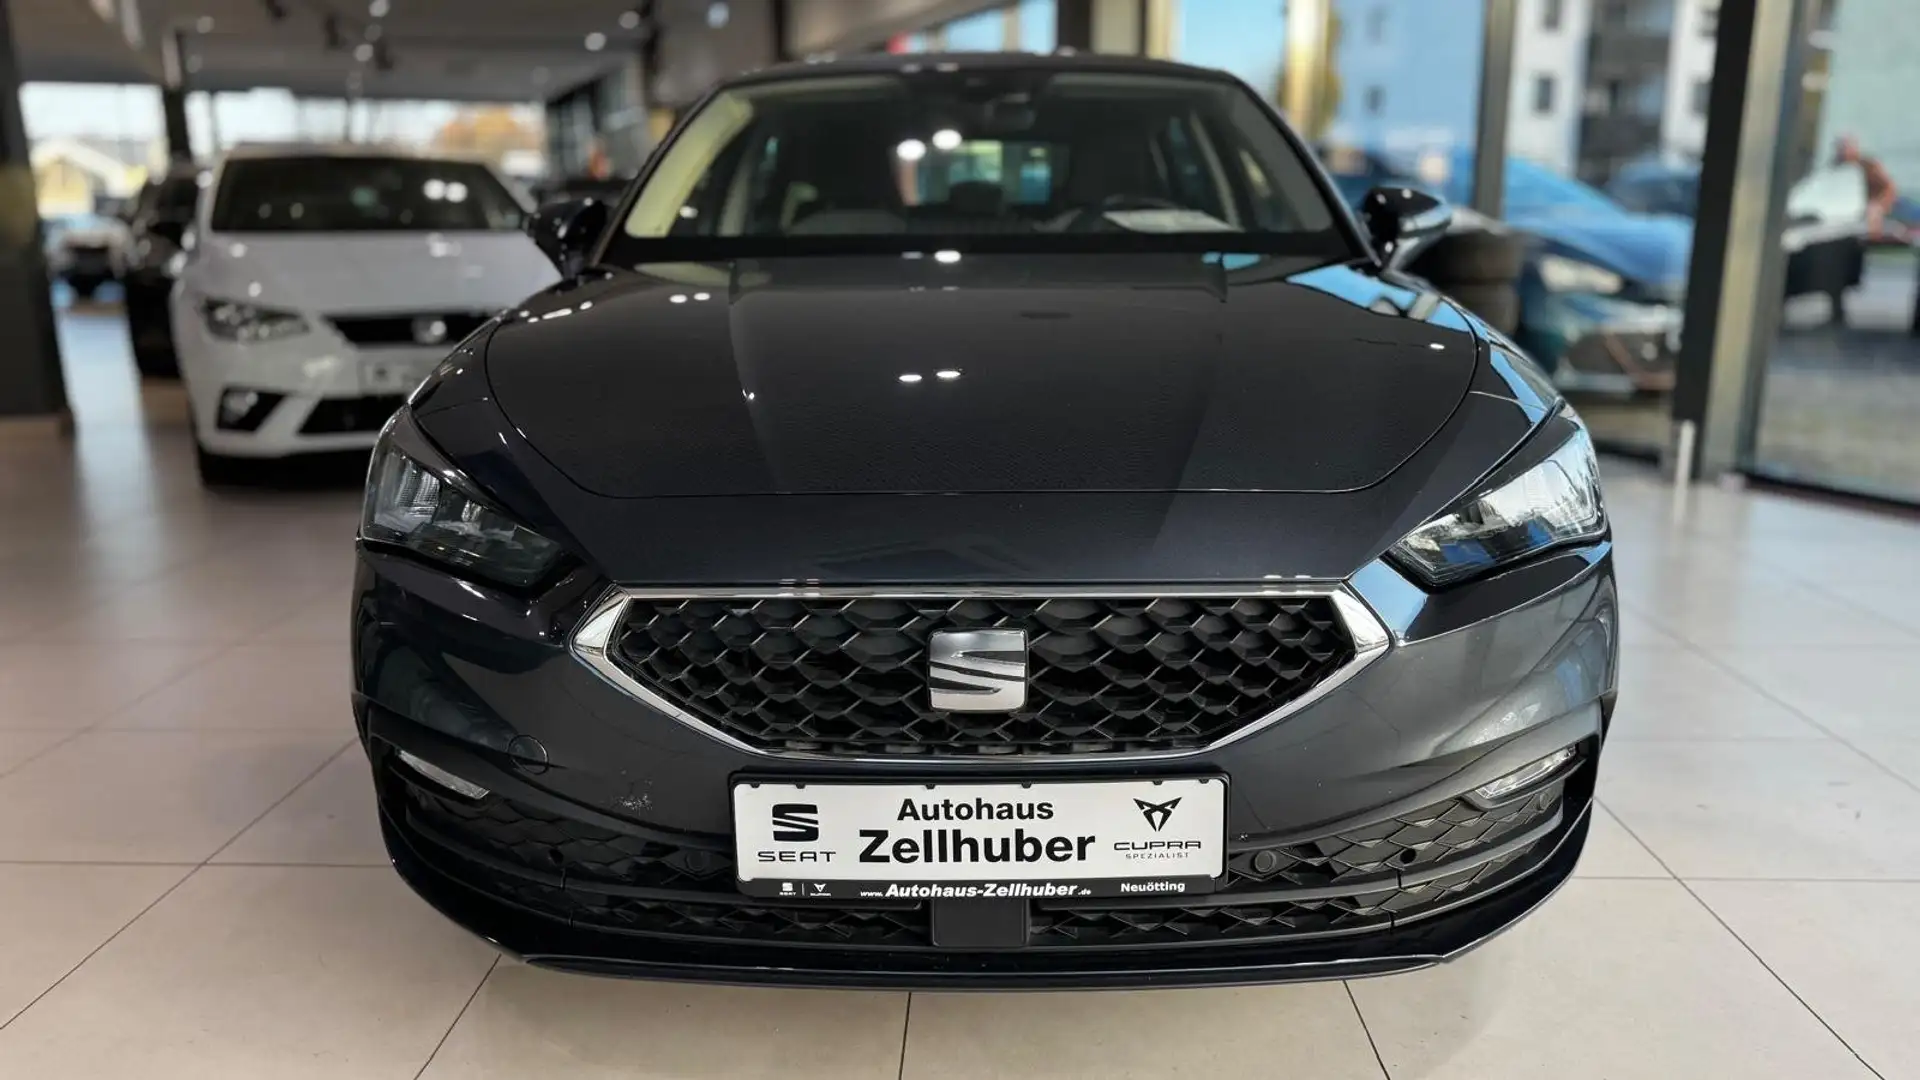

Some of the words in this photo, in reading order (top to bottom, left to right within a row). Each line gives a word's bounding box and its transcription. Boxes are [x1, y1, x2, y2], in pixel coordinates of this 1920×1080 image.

[896, 798, 1054, 821] Autohaus
[858, 828, 1096, 863] Zellhuber
[1113, 840, 1202, 851] CUPRA
[757, 850, 837, 863] SEAT
[1125, 851, 1190, 860] SPEZIALIST
[1120, 880, 1186, 896] Neuötting
